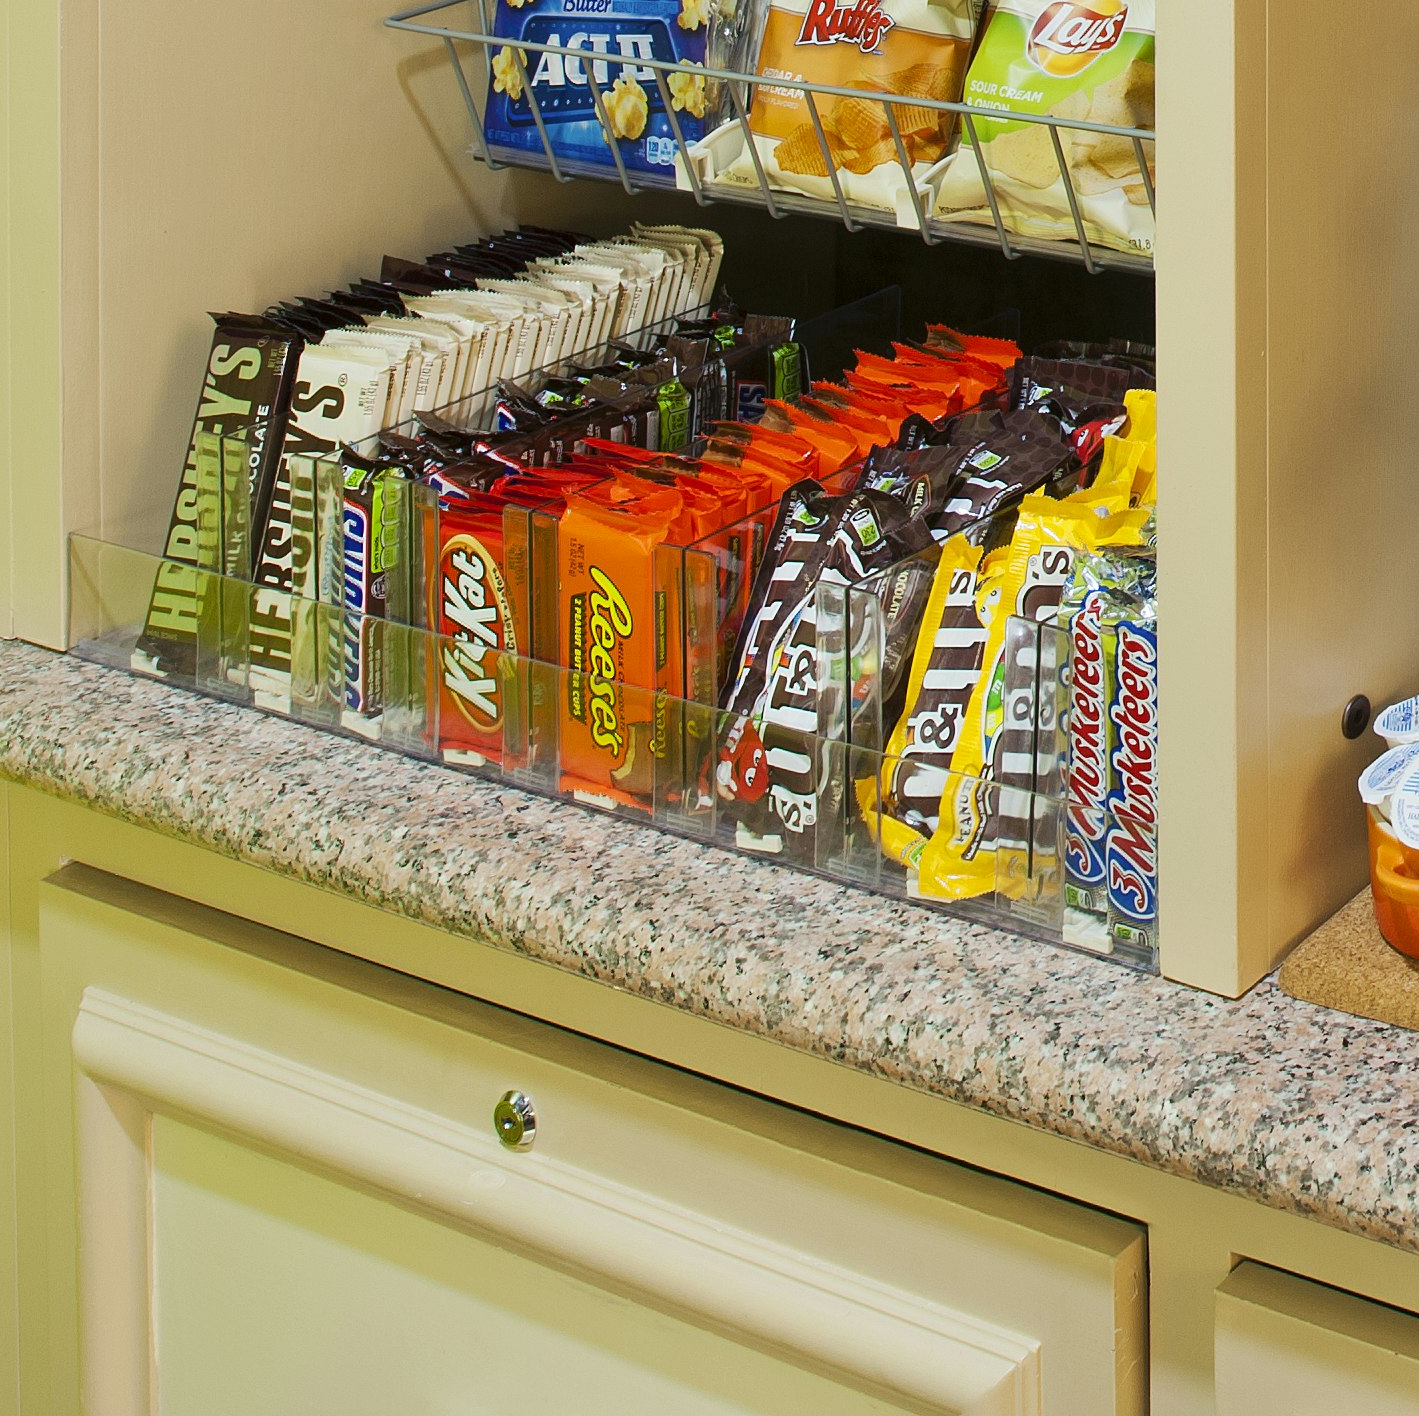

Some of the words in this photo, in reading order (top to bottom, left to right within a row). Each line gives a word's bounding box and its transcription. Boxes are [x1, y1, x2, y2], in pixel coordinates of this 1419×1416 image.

[1036, 5, 1127, 54] Lay's
[531, 31, 609, 87] ACT
[614, 34, 657, 82] II
[970, 79, 997, 97] SOUR
[999, 85, 1043, 103] CREAM
[974, 97, 1010, 112] ONION
[149, 343, 261, 634] HERSHEY'S
[574, 606, 583, 643] PEANUT
[589, 565, 633, 759] Reese's
[572, 692, 582, 717] CUPS
[1068, 596, 1103, 840] Musketeers
[1110, 630, 1157, 881] Musketeers
[1066, 836, 1091, 872] 3
[1110, 866, 1148, 911] 3
